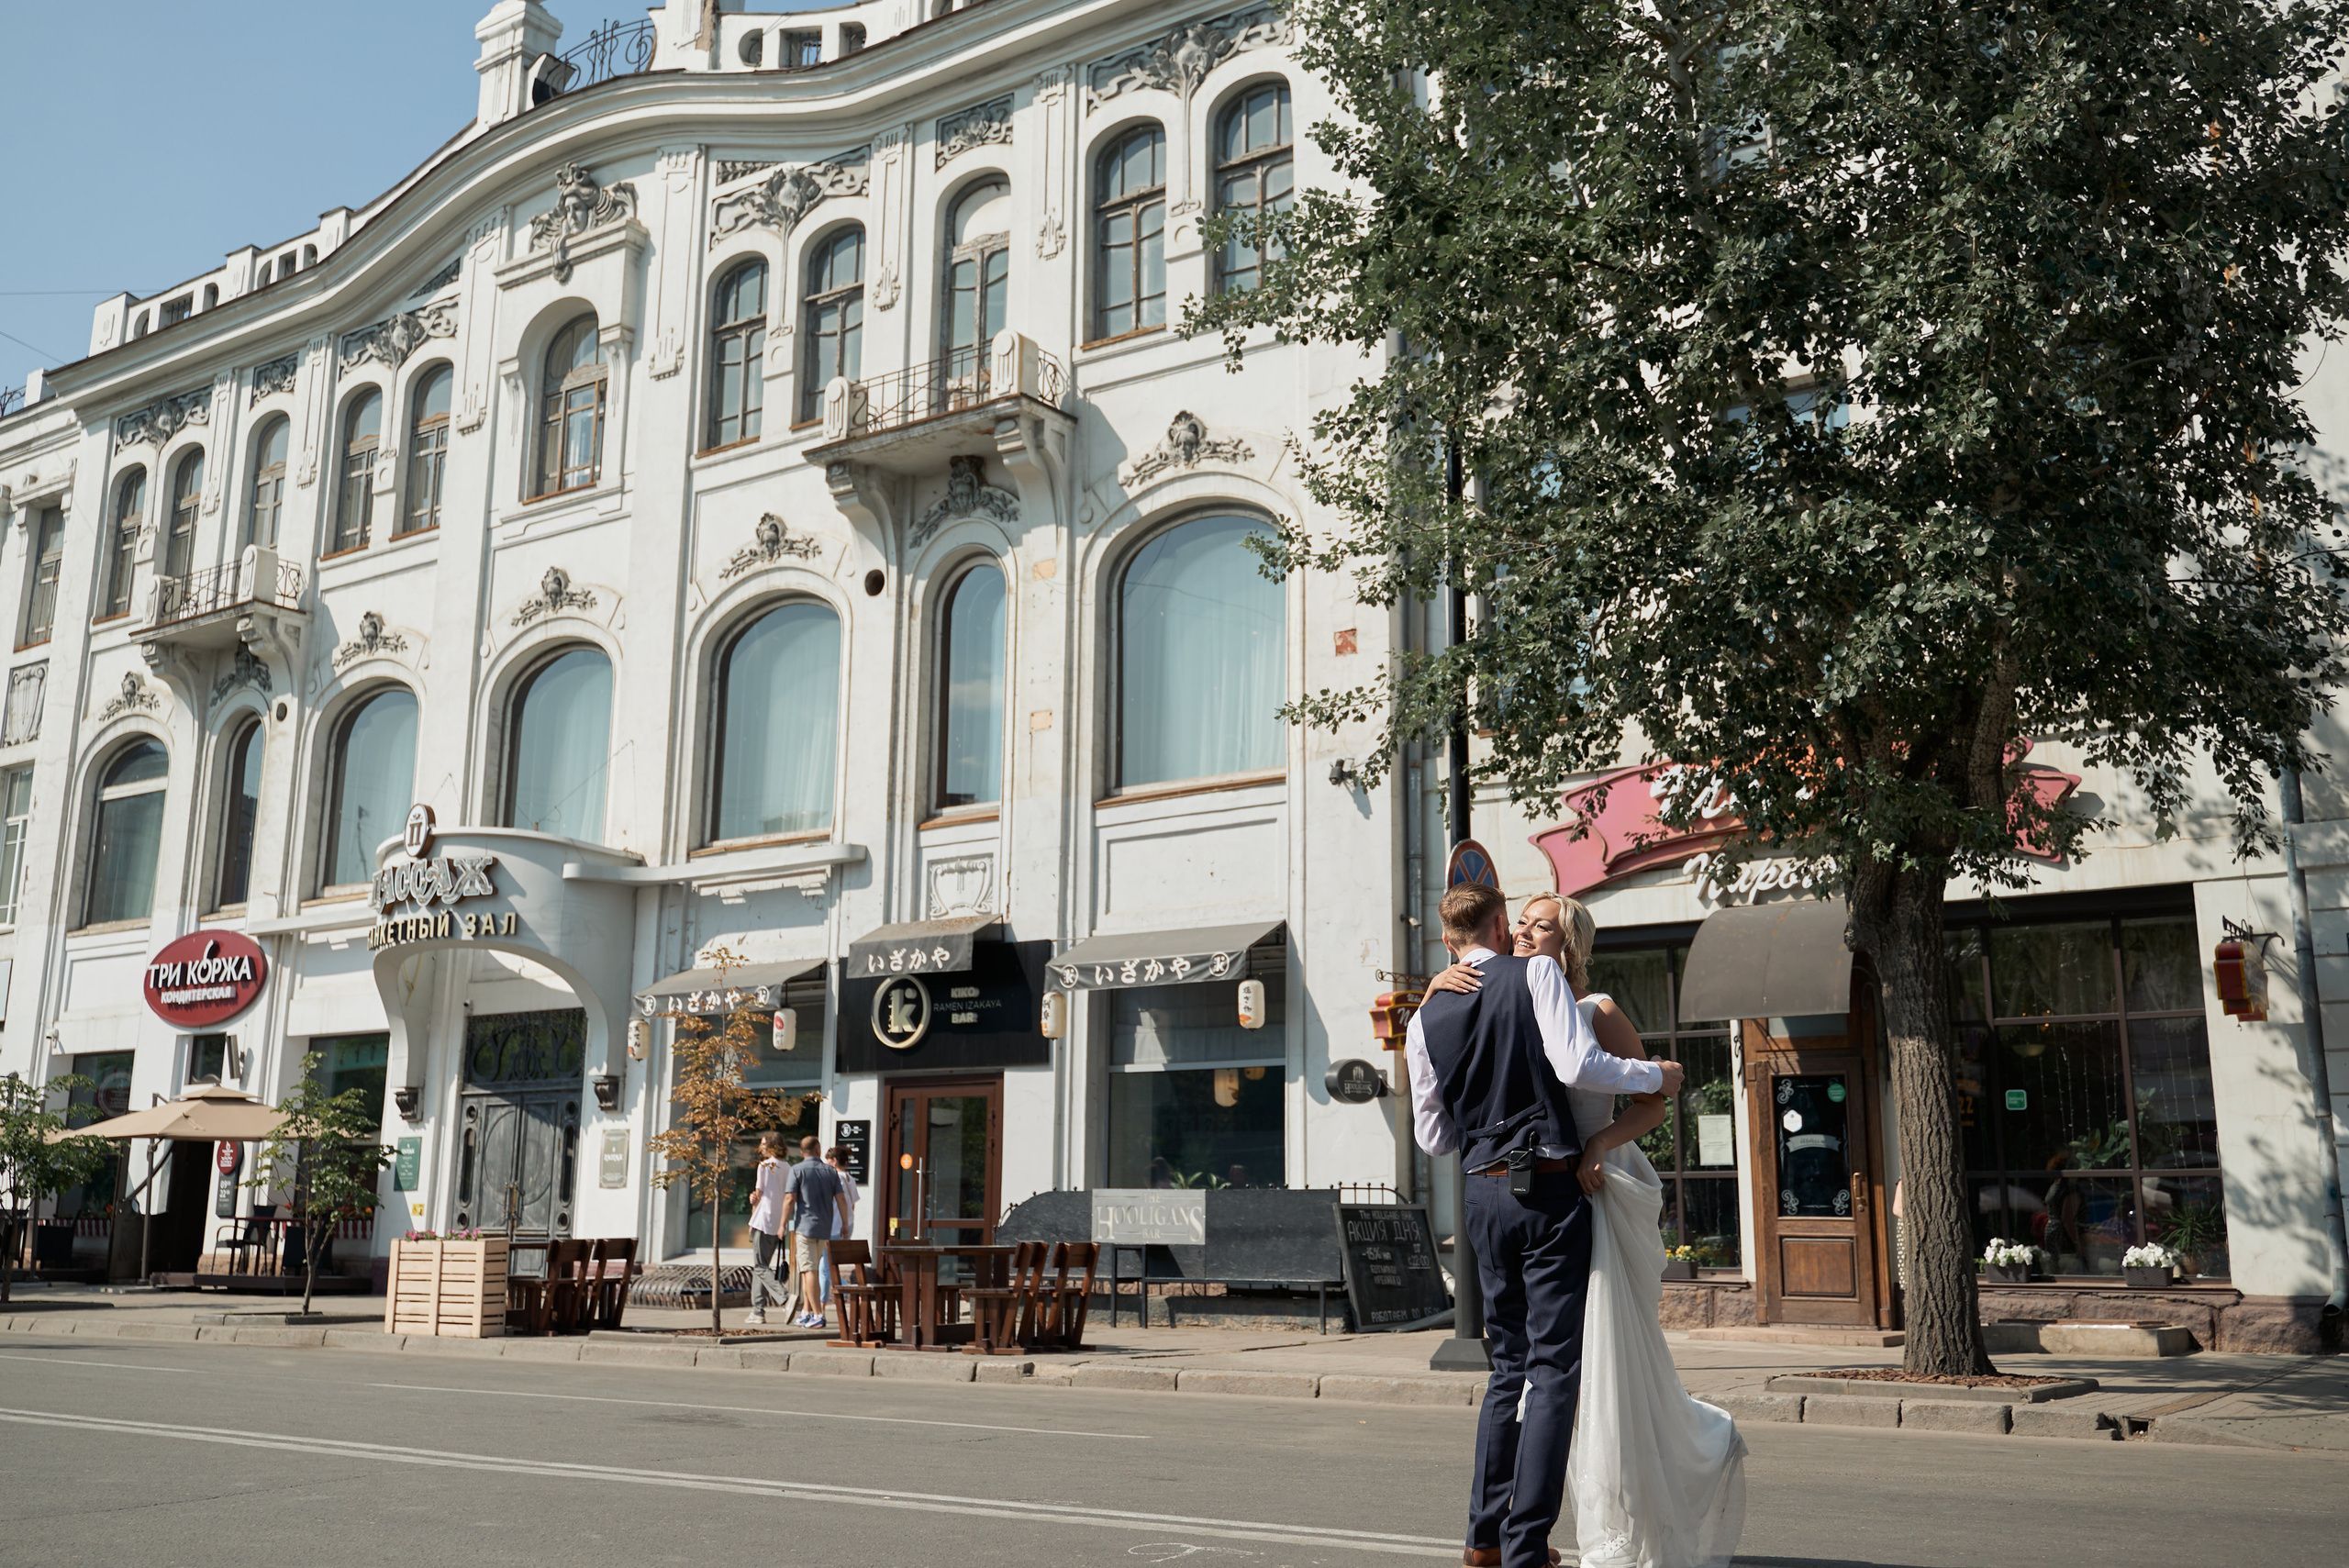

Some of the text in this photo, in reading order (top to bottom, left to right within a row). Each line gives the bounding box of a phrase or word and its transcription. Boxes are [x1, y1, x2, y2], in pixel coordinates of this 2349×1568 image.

[406, 822, 423, 847] П
[368, 856, 495, 914] ПАССАЖ
[368, 908, 518, 951] АНКЕТНЫЙ ЗАЛ
[148, 945, 252, 989] ТРИ КОРЖА
[867, 946, 951, 973] いざかや
[1095, 955, 1192, 985] いざかや
[161, 985, 233, 1005] КОНДИТЕРСКАЯ
[668, 989, 741, 1013] いざかや
[951, 986, 979, 998] KIKO
[933, 998, 1002, 1013] RAMEN IZAKAYA
[951, 1012, 977, 1024] BAR
[1142, 1193, 1162, 1204] THE
[1095, 1205, 1204, 1242] HOOLIGANS
[1141, 1228, 1162, 1240] BAR
[1347, 1220, 1388, 1242] АКЦИЯ
[1371, 1309, 1409, 1323] РАБОТАЕМ
